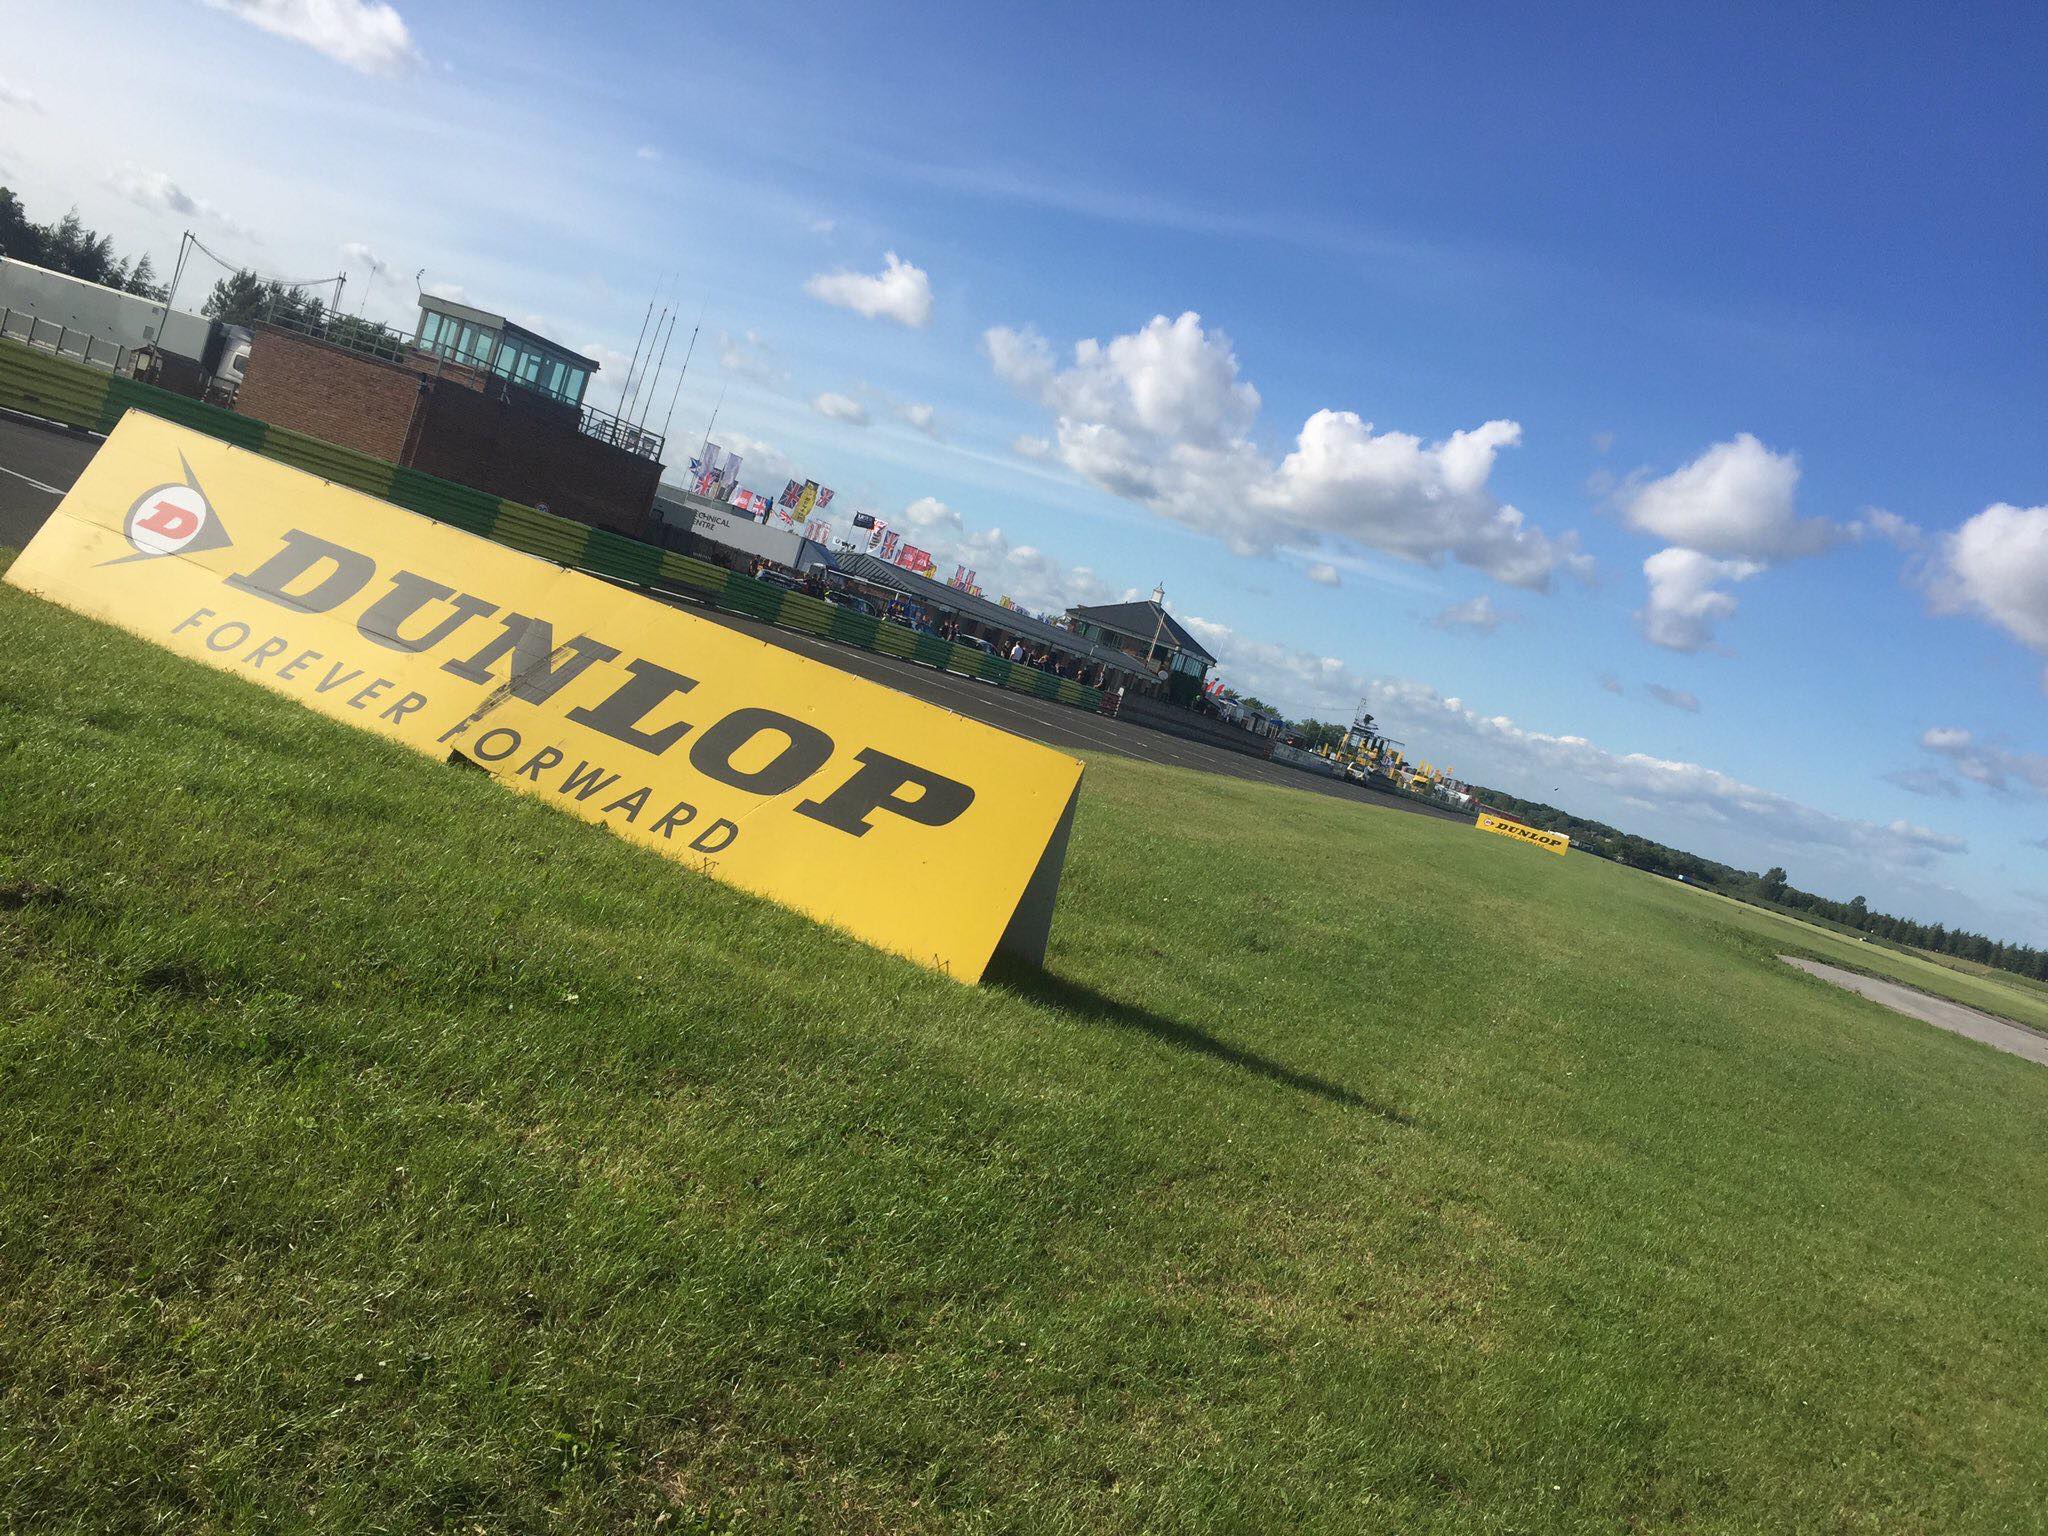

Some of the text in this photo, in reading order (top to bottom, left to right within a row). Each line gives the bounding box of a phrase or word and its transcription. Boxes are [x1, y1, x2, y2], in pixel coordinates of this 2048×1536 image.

[136, 501, 198, 540] D
[171, 608, 427, 724] FOREVER
[223, 529, 975, 838] DUNLOP
[1495, 823, 1562, 847] DUNLOP
